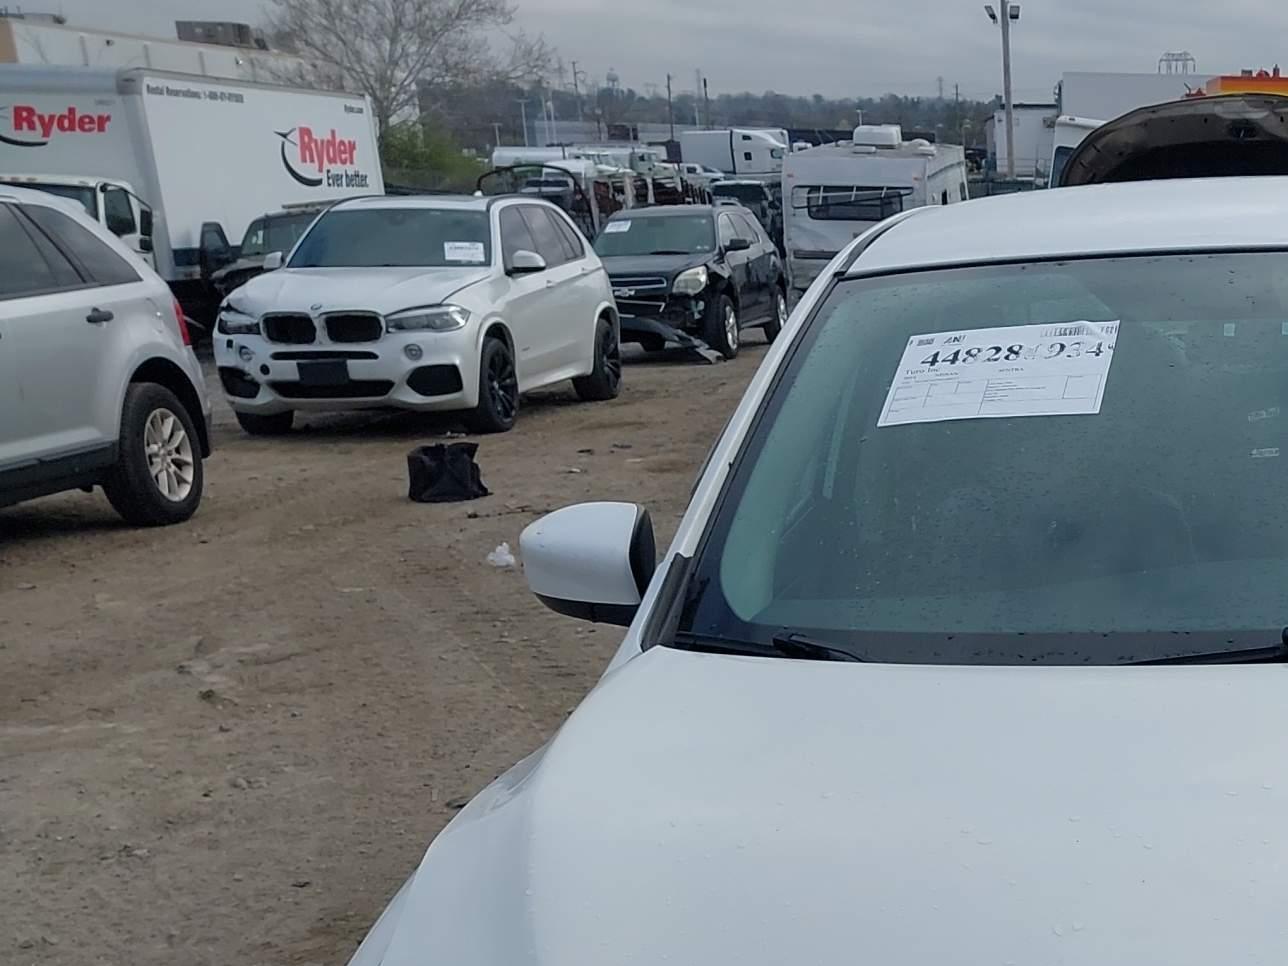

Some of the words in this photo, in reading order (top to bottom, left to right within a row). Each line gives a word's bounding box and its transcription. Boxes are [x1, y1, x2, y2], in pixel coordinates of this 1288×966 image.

[13, 104, 112, 138] Ryder
[298, 126, 357, 173] Ryder
[326, 168, 343, 188] Ever
